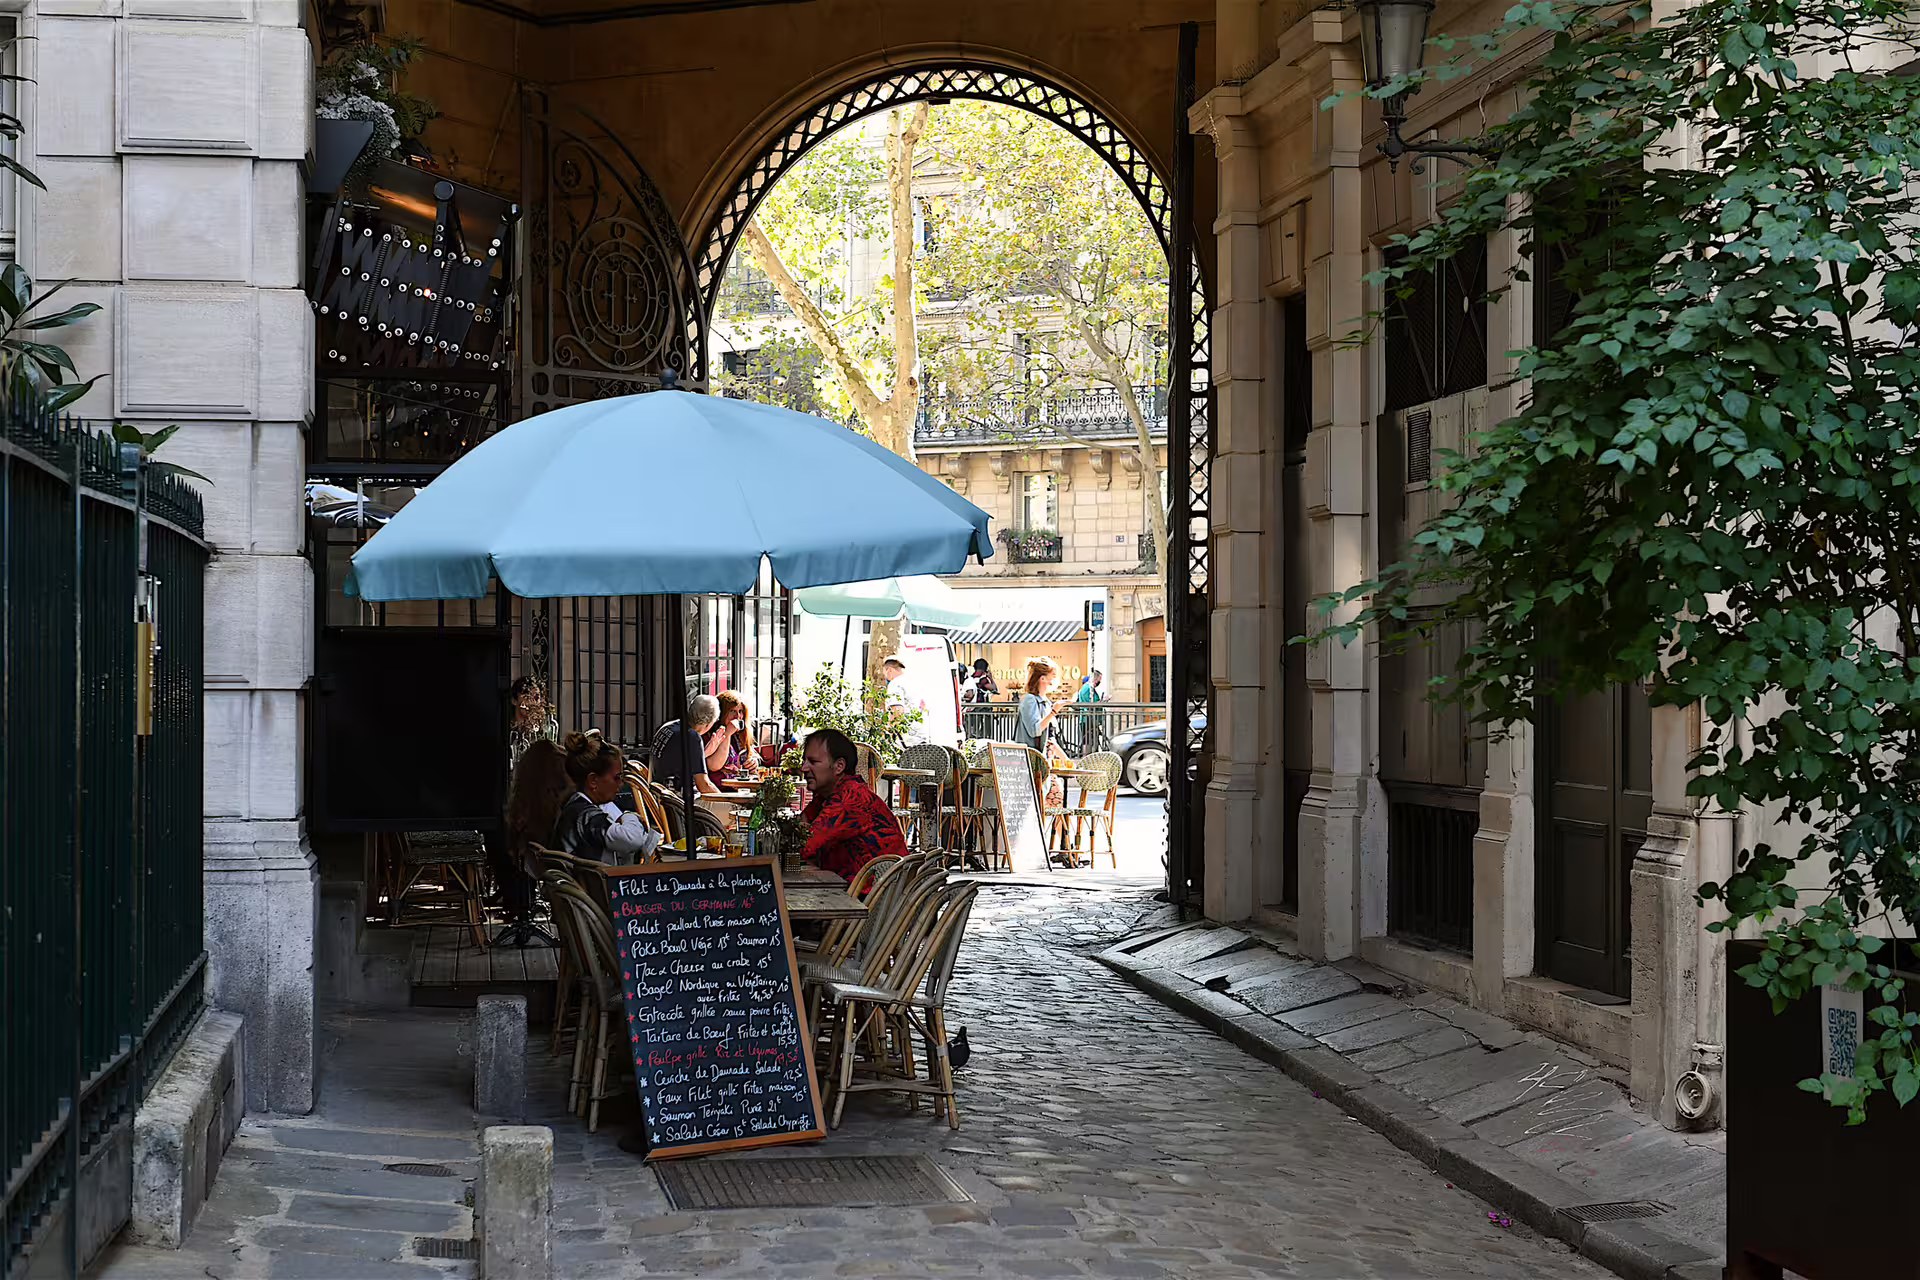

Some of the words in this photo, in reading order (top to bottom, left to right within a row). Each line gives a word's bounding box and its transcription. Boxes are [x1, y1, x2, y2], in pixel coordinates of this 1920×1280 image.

[619, 880, 648, 896] Filet
[656, 879, 669, 892] de
[708, 880, 714, 888] à
[718, 872, 729, 888] la
[622, 902, 666, 917] BURGER
[672, 901, 684, 911] DU
[628, 919, 660, 937] Poulet
[728, 917, 754, 927] maison
[661, 938, 688, 953] Bowl
[691, 937, 712, 956] Végé
[737, 934, 767, 946] Saumon
[636, 962, 657, 981] Mac
[670, 960, 705, 975] Cheese
[712, 961, 723, 969] au
[727, 952, 750, 968] crabe
[637, 979, 673, 1000] Bagel
[680, 979, 719, 994] Nordique
[697, 995, 716, 1003] avec
[691, 1004, 715, 1024] grillée
[722, 1009, 746, 1017] sauce
[750, 1008, 770, 1022] poivre
[642, 1028, 681, 1043] Tartare
[687, 1027, 700, 1039] de
[771, 1023, 797, 1036] Salade
[648, 1050, 681, 1068] Poulpe
[686, 1045, 707, 1068] grillé
[734, 1047, 744, 1058] et
[654, 1070, 690, 1086] Ceviche
[695, 1067, 708, 1079] de
[710, 1064, 750, 1082] Daurade
[755, 1062, 781, 1075] Salade
[657, 1087, 682, 1105] Faux
[689, 1085, 712, 1102] Filet
[718, 1083, 739, 1105] grillé
[744, 1080, 763, 1095] Frites
[768, 1083, 796, 1092] maison
[659, 1108, 695, 1124] Saumon
[665, 1124, 702, 1142] Salade
[706, 1123, 730, 1137] César
[750, 1117, 777, 1131] Salade
